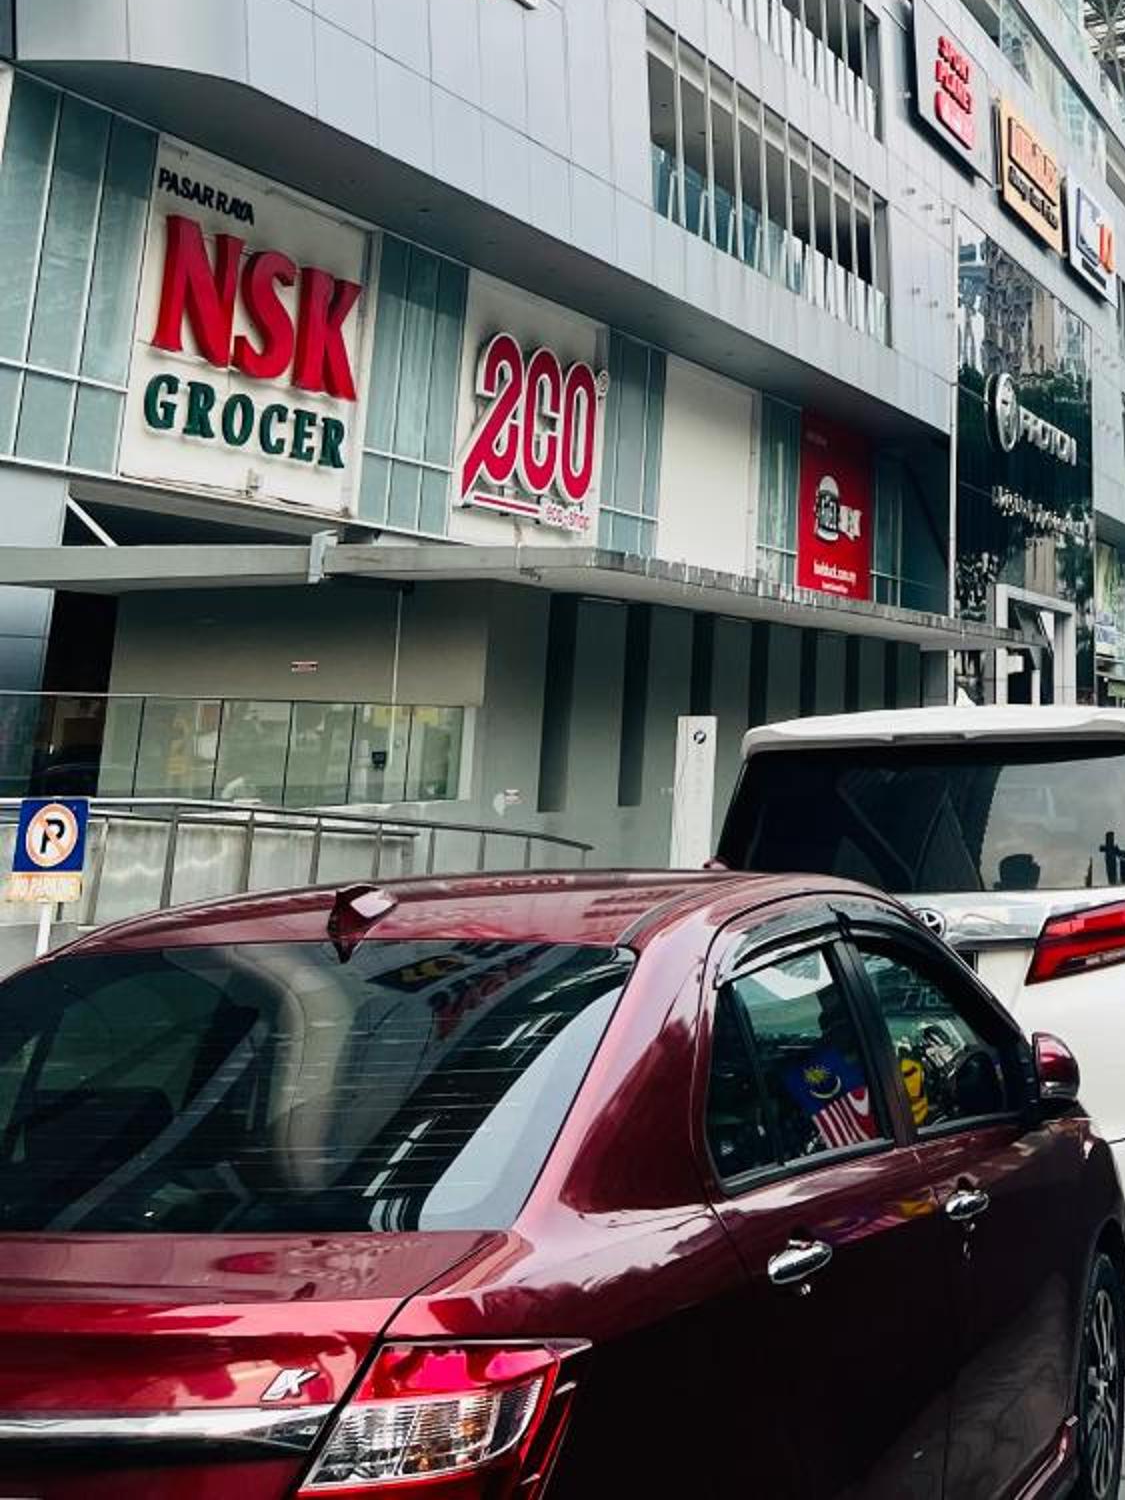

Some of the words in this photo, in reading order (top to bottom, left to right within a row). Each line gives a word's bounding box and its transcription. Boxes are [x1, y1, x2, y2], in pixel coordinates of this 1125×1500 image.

[158, 167, 214, 209] PASAR
[215, 189, 254, 227] RAYA
[150, 214, 363, 402] NSK
[143, 373, 346, 469] GROCER
[1018, 404, 1078, 467] PROTON
